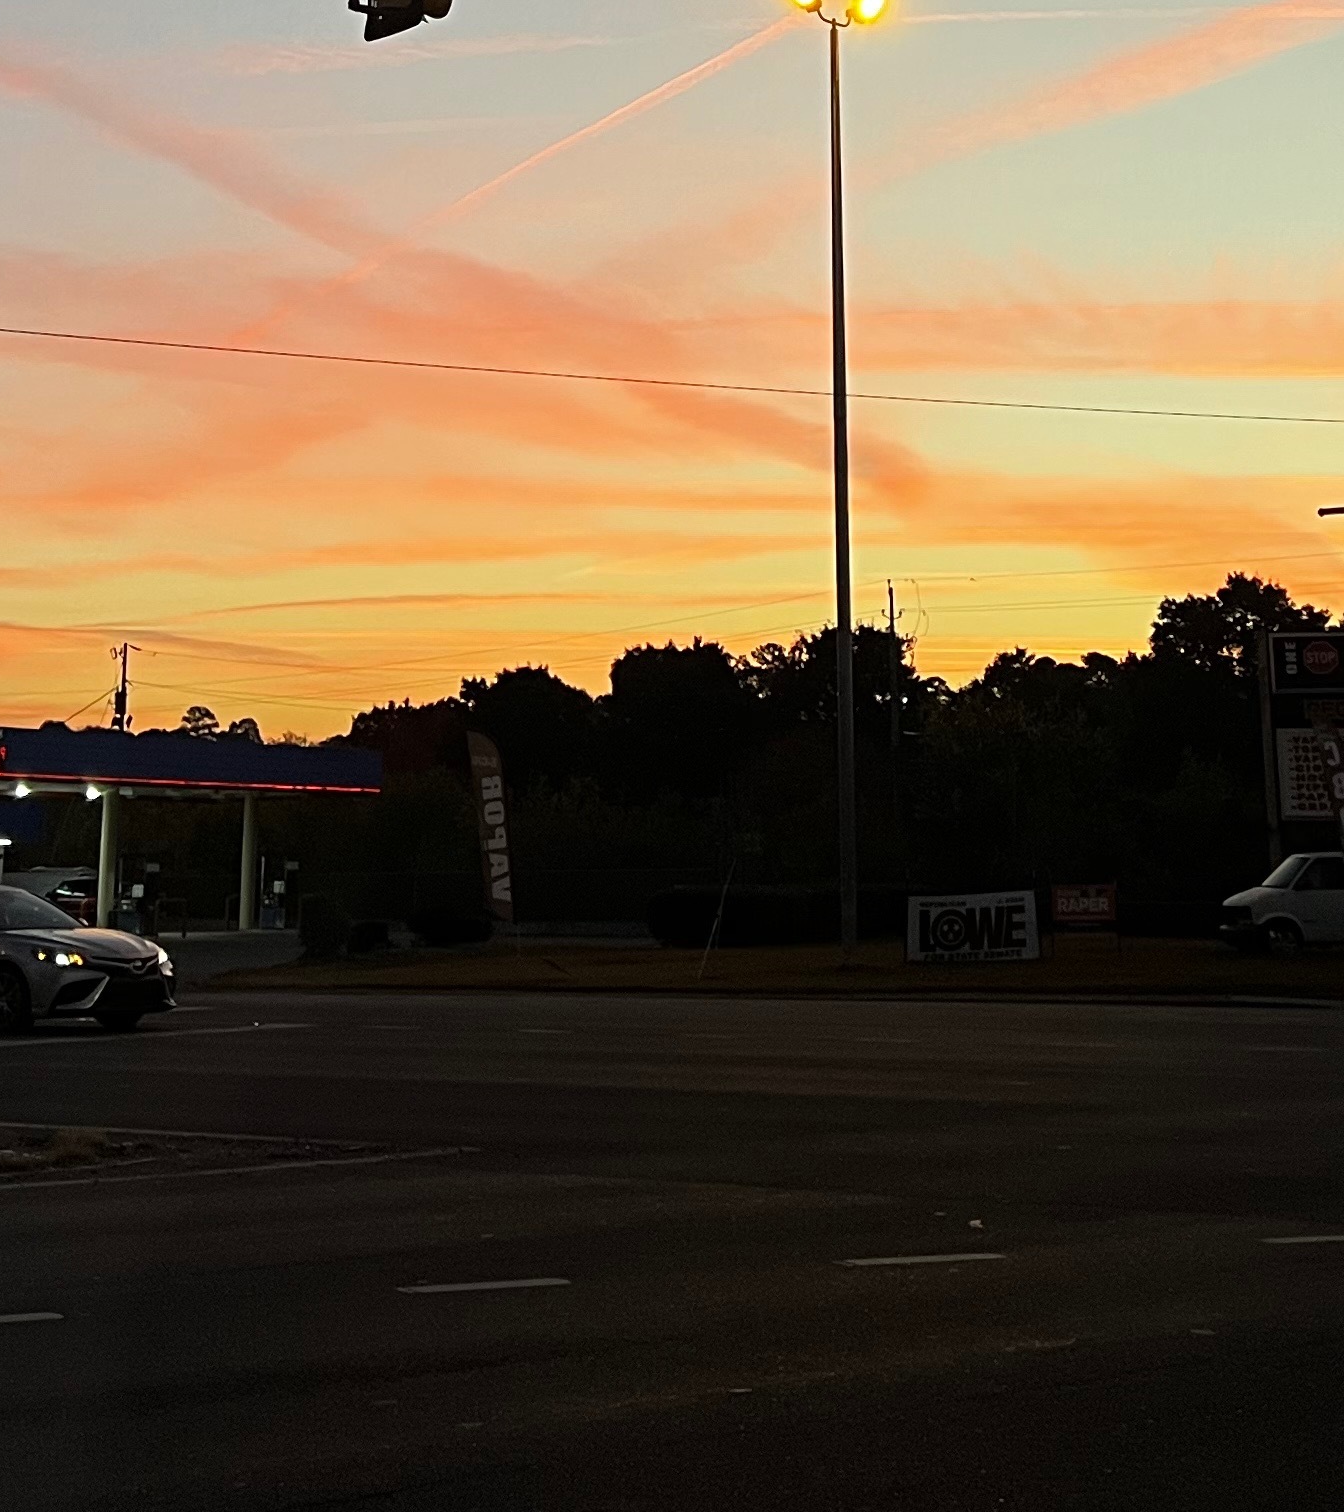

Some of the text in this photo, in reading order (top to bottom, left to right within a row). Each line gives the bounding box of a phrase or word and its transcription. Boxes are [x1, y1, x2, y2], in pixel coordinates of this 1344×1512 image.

[1305, 650, 1335, 664] STOP
[1057, 897, 1109, 913] RAPER
[919, 905, 1027, 952] LOWE
